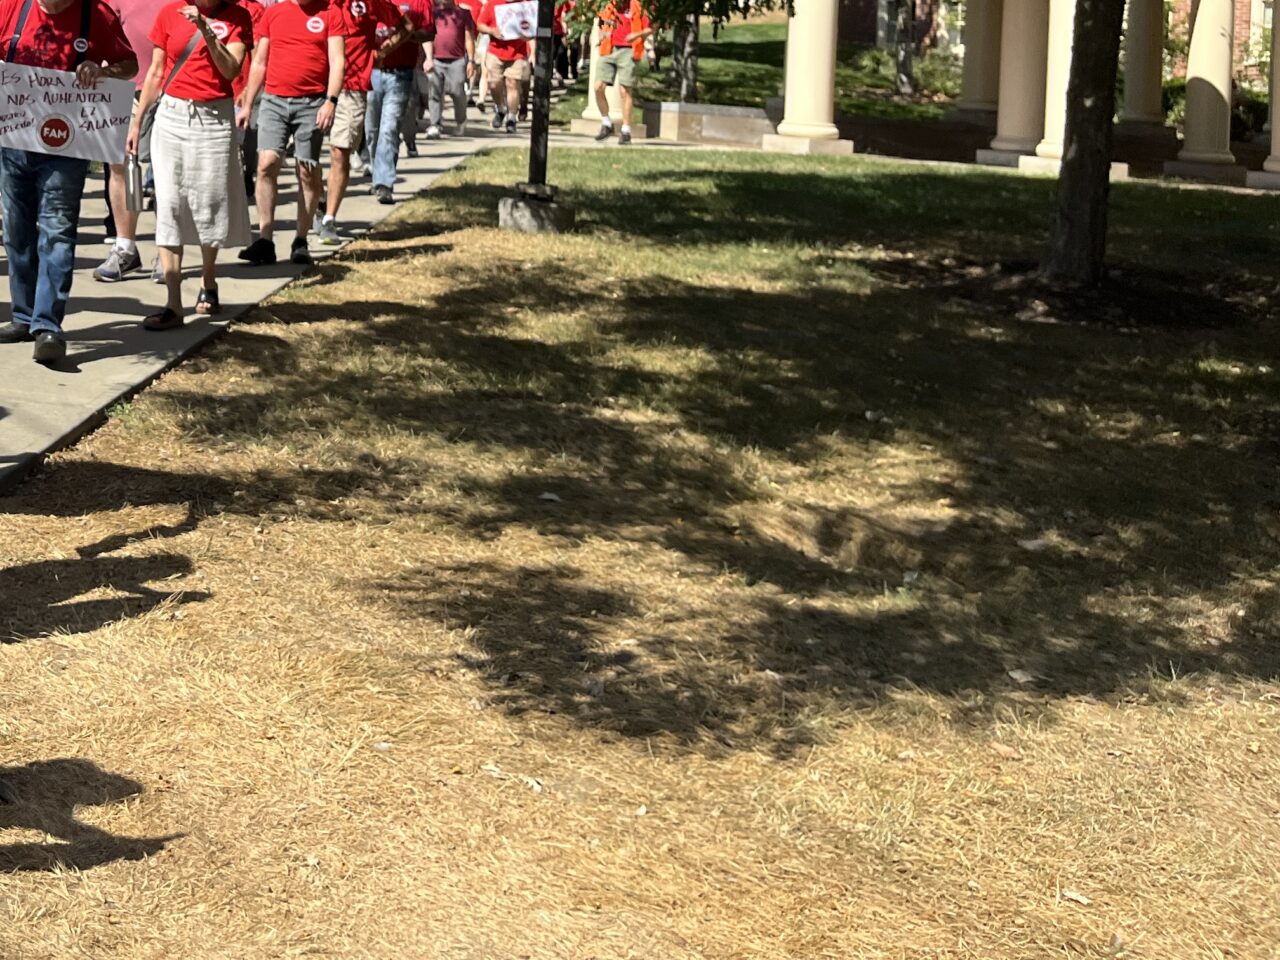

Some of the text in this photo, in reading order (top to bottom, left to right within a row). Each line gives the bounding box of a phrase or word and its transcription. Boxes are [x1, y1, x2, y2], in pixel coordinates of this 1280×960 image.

[2, 71, 21, 85] ES
[28, 72, 65, 88] HORA
[7, 94, 35, 106] NOS
[43, 127, 67, 139] FAM
